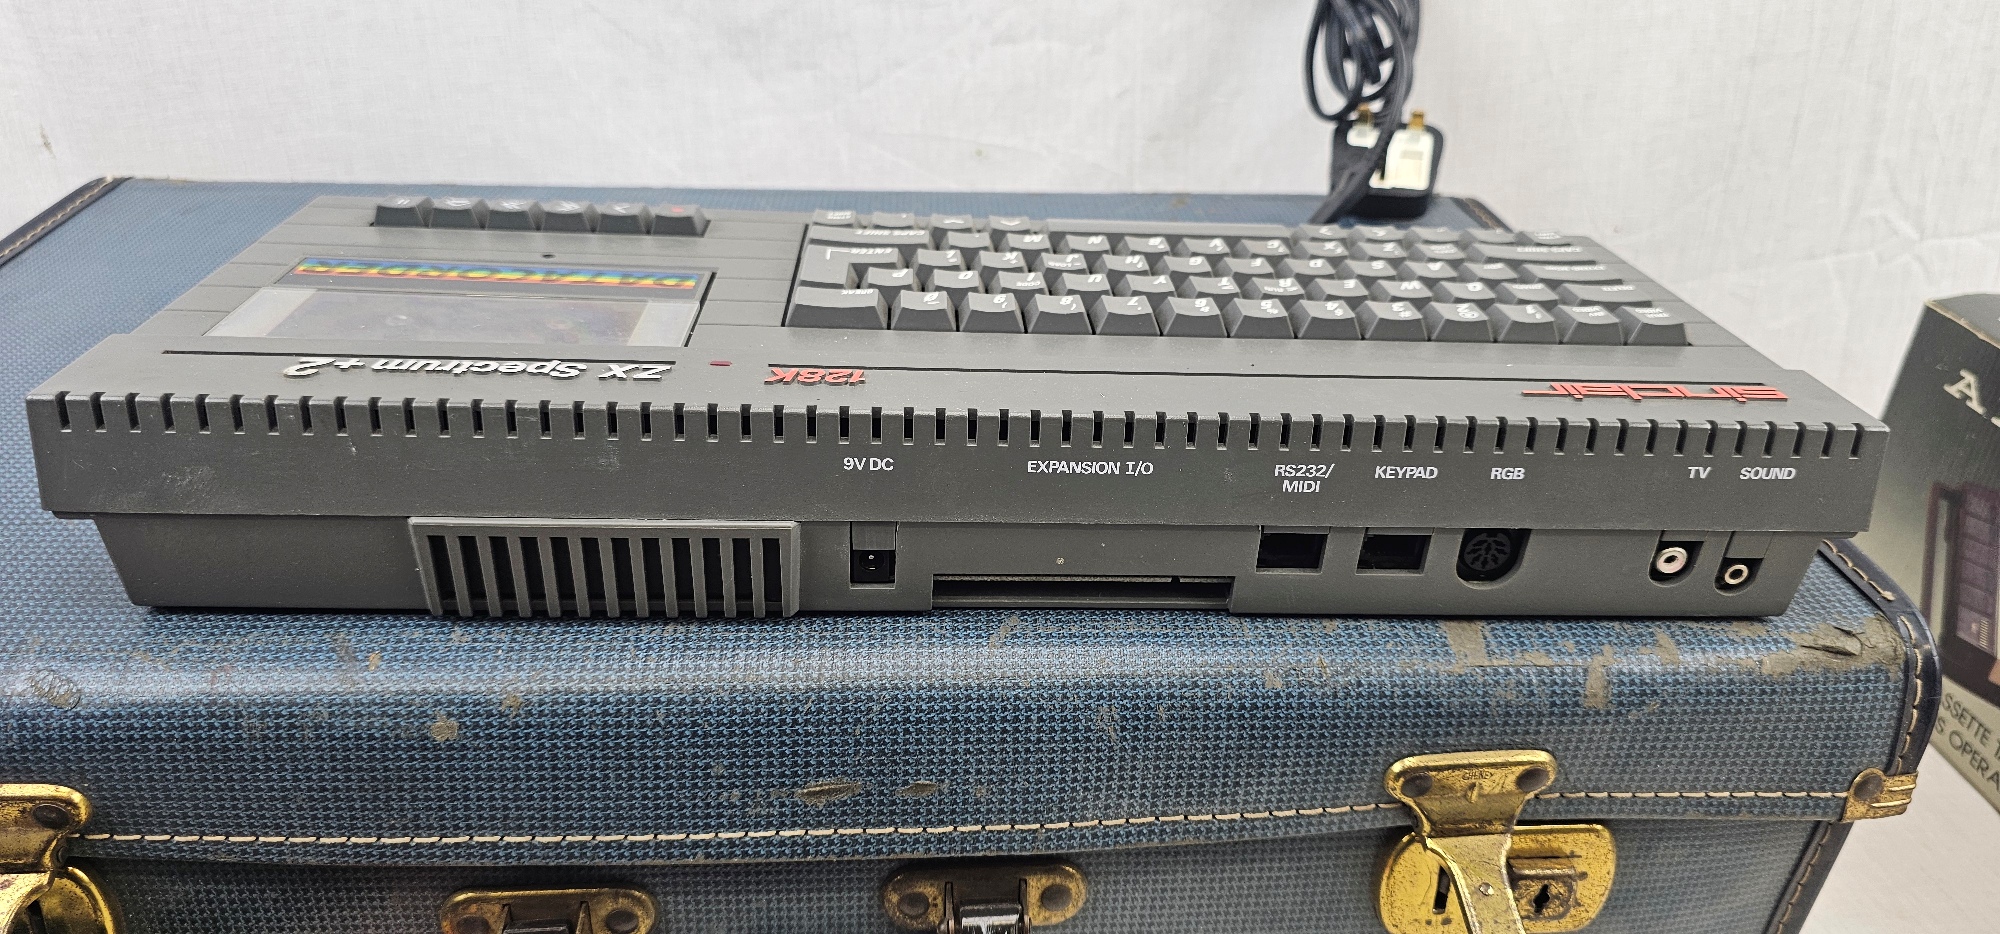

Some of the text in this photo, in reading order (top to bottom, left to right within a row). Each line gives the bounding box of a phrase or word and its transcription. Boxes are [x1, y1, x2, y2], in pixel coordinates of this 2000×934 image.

[1023, 234, 1044, 243] M
[1324, 241, 1339, 250] X
[1383, 242, 1397, 251] Z
[1002, 251, 1019, 261] K
[1123, 255, 1141, 264] H
[1250, 257, 1263, 267] F
[1370, 260, 1385, 270] S
[1426, 261, 1444, 271] A
[303, 261, 692, 288] DATACORDER
[1152, 275, 1167, 285] Y
[1343, 278, 1357, 289] E
[1399, 280, 1421, 291] W
[993, 293, 1007, 304] 9
[1059, 296, 1074, 306] 8
[1127, 297, 1140, 306] 7
[1194, 299, 1208, 308] 6
[1260, 299, 1273, 310] 5
[1324, 301, 1339, 311] 4
[1391, 302, 1405, 312] 3
[1456, 304, 1471, 313] 2
[370, 359, 588, 380] Spectrum
[599, 363, 673, 381] ZX
[765, 368, 867, 387] 128K
[843, 458, 895, 471] 9V DC
[1027, 460, 1154, 476] EXPANSION I/O
[1274, 463, 1336, 478] RS232/
[1375, 465, 1439, 479] KEYPAD
[1490, 467, 1526, 480] RGB
[1687, 466, 1712, 479] TV
[1740, 466, 1796, 480] SOUND
[1282, 480, 1320, 493] MIDI
